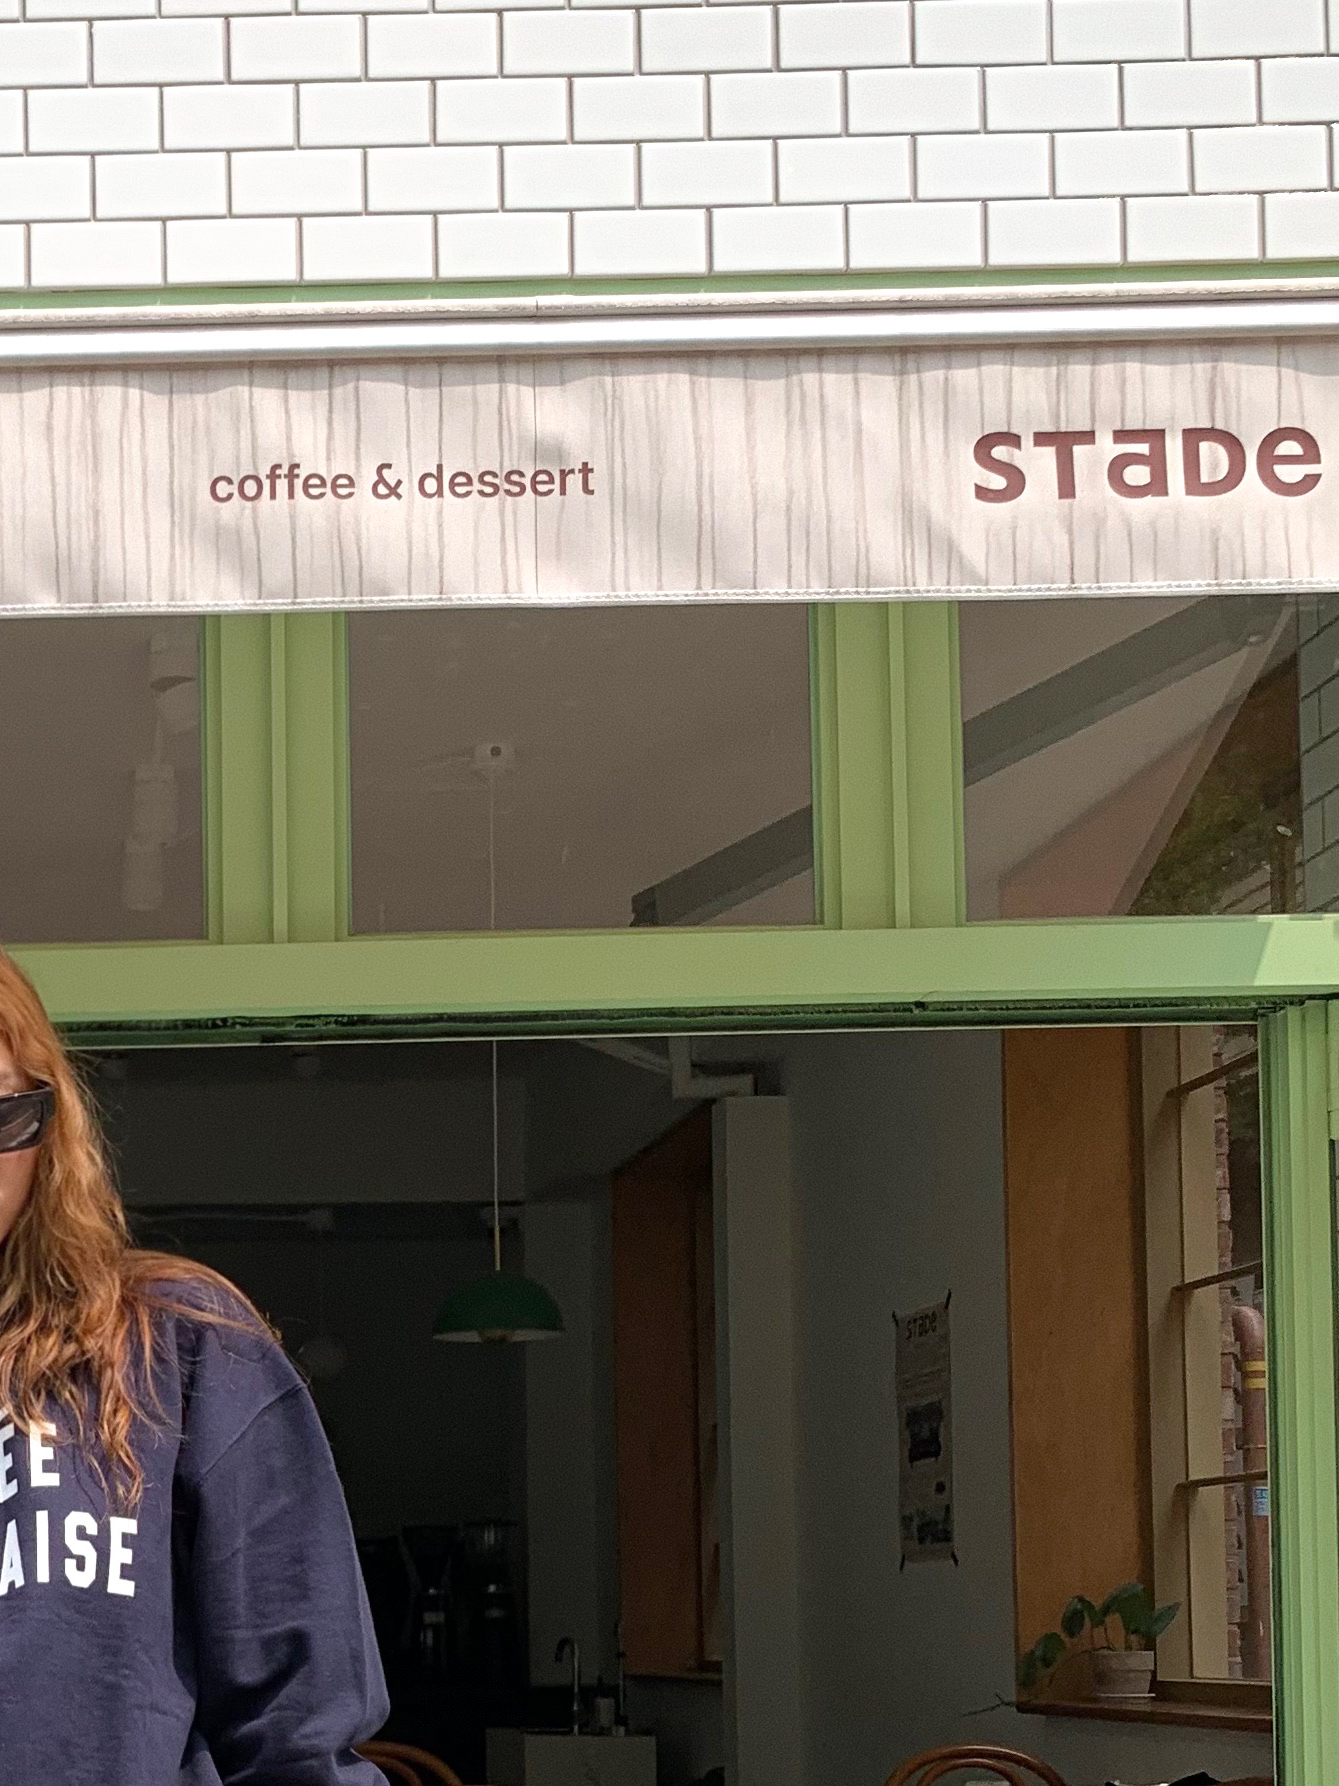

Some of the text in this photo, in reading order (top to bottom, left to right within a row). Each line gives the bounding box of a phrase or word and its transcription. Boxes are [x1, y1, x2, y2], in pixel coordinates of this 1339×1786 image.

[209, 459, 596, 502] coffee & dessert
